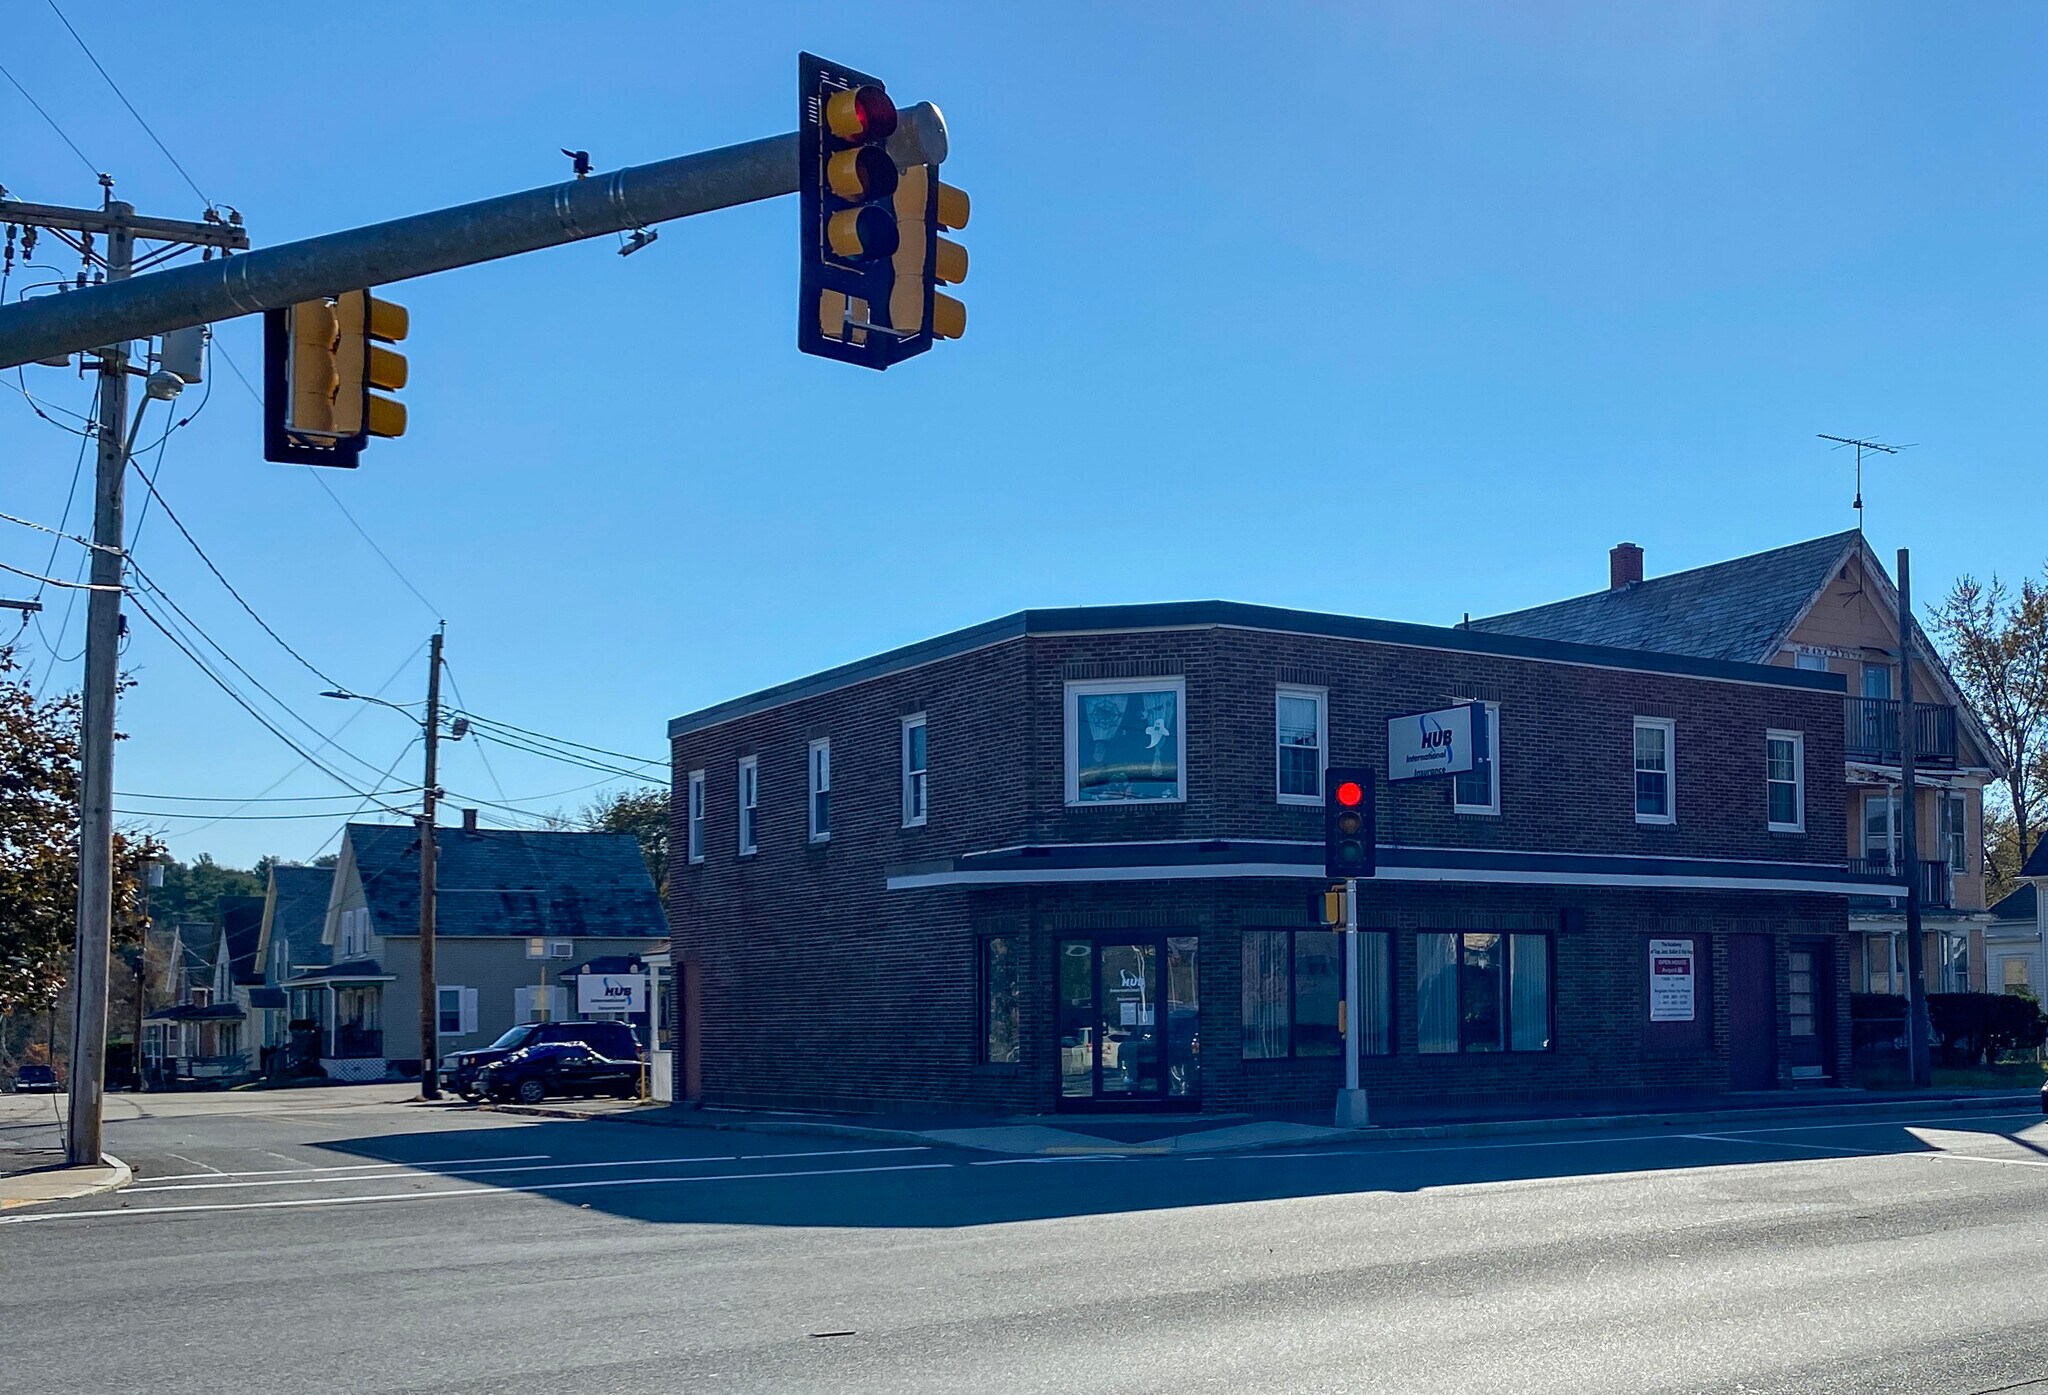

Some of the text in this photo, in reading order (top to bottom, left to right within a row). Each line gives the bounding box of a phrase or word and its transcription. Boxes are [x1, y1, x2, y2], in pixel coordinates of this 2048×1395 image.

[1421, 729, 1453, 749] HUB
[1406, 749, 1447, 763] International
[604, 987, 632, 996] HUB
